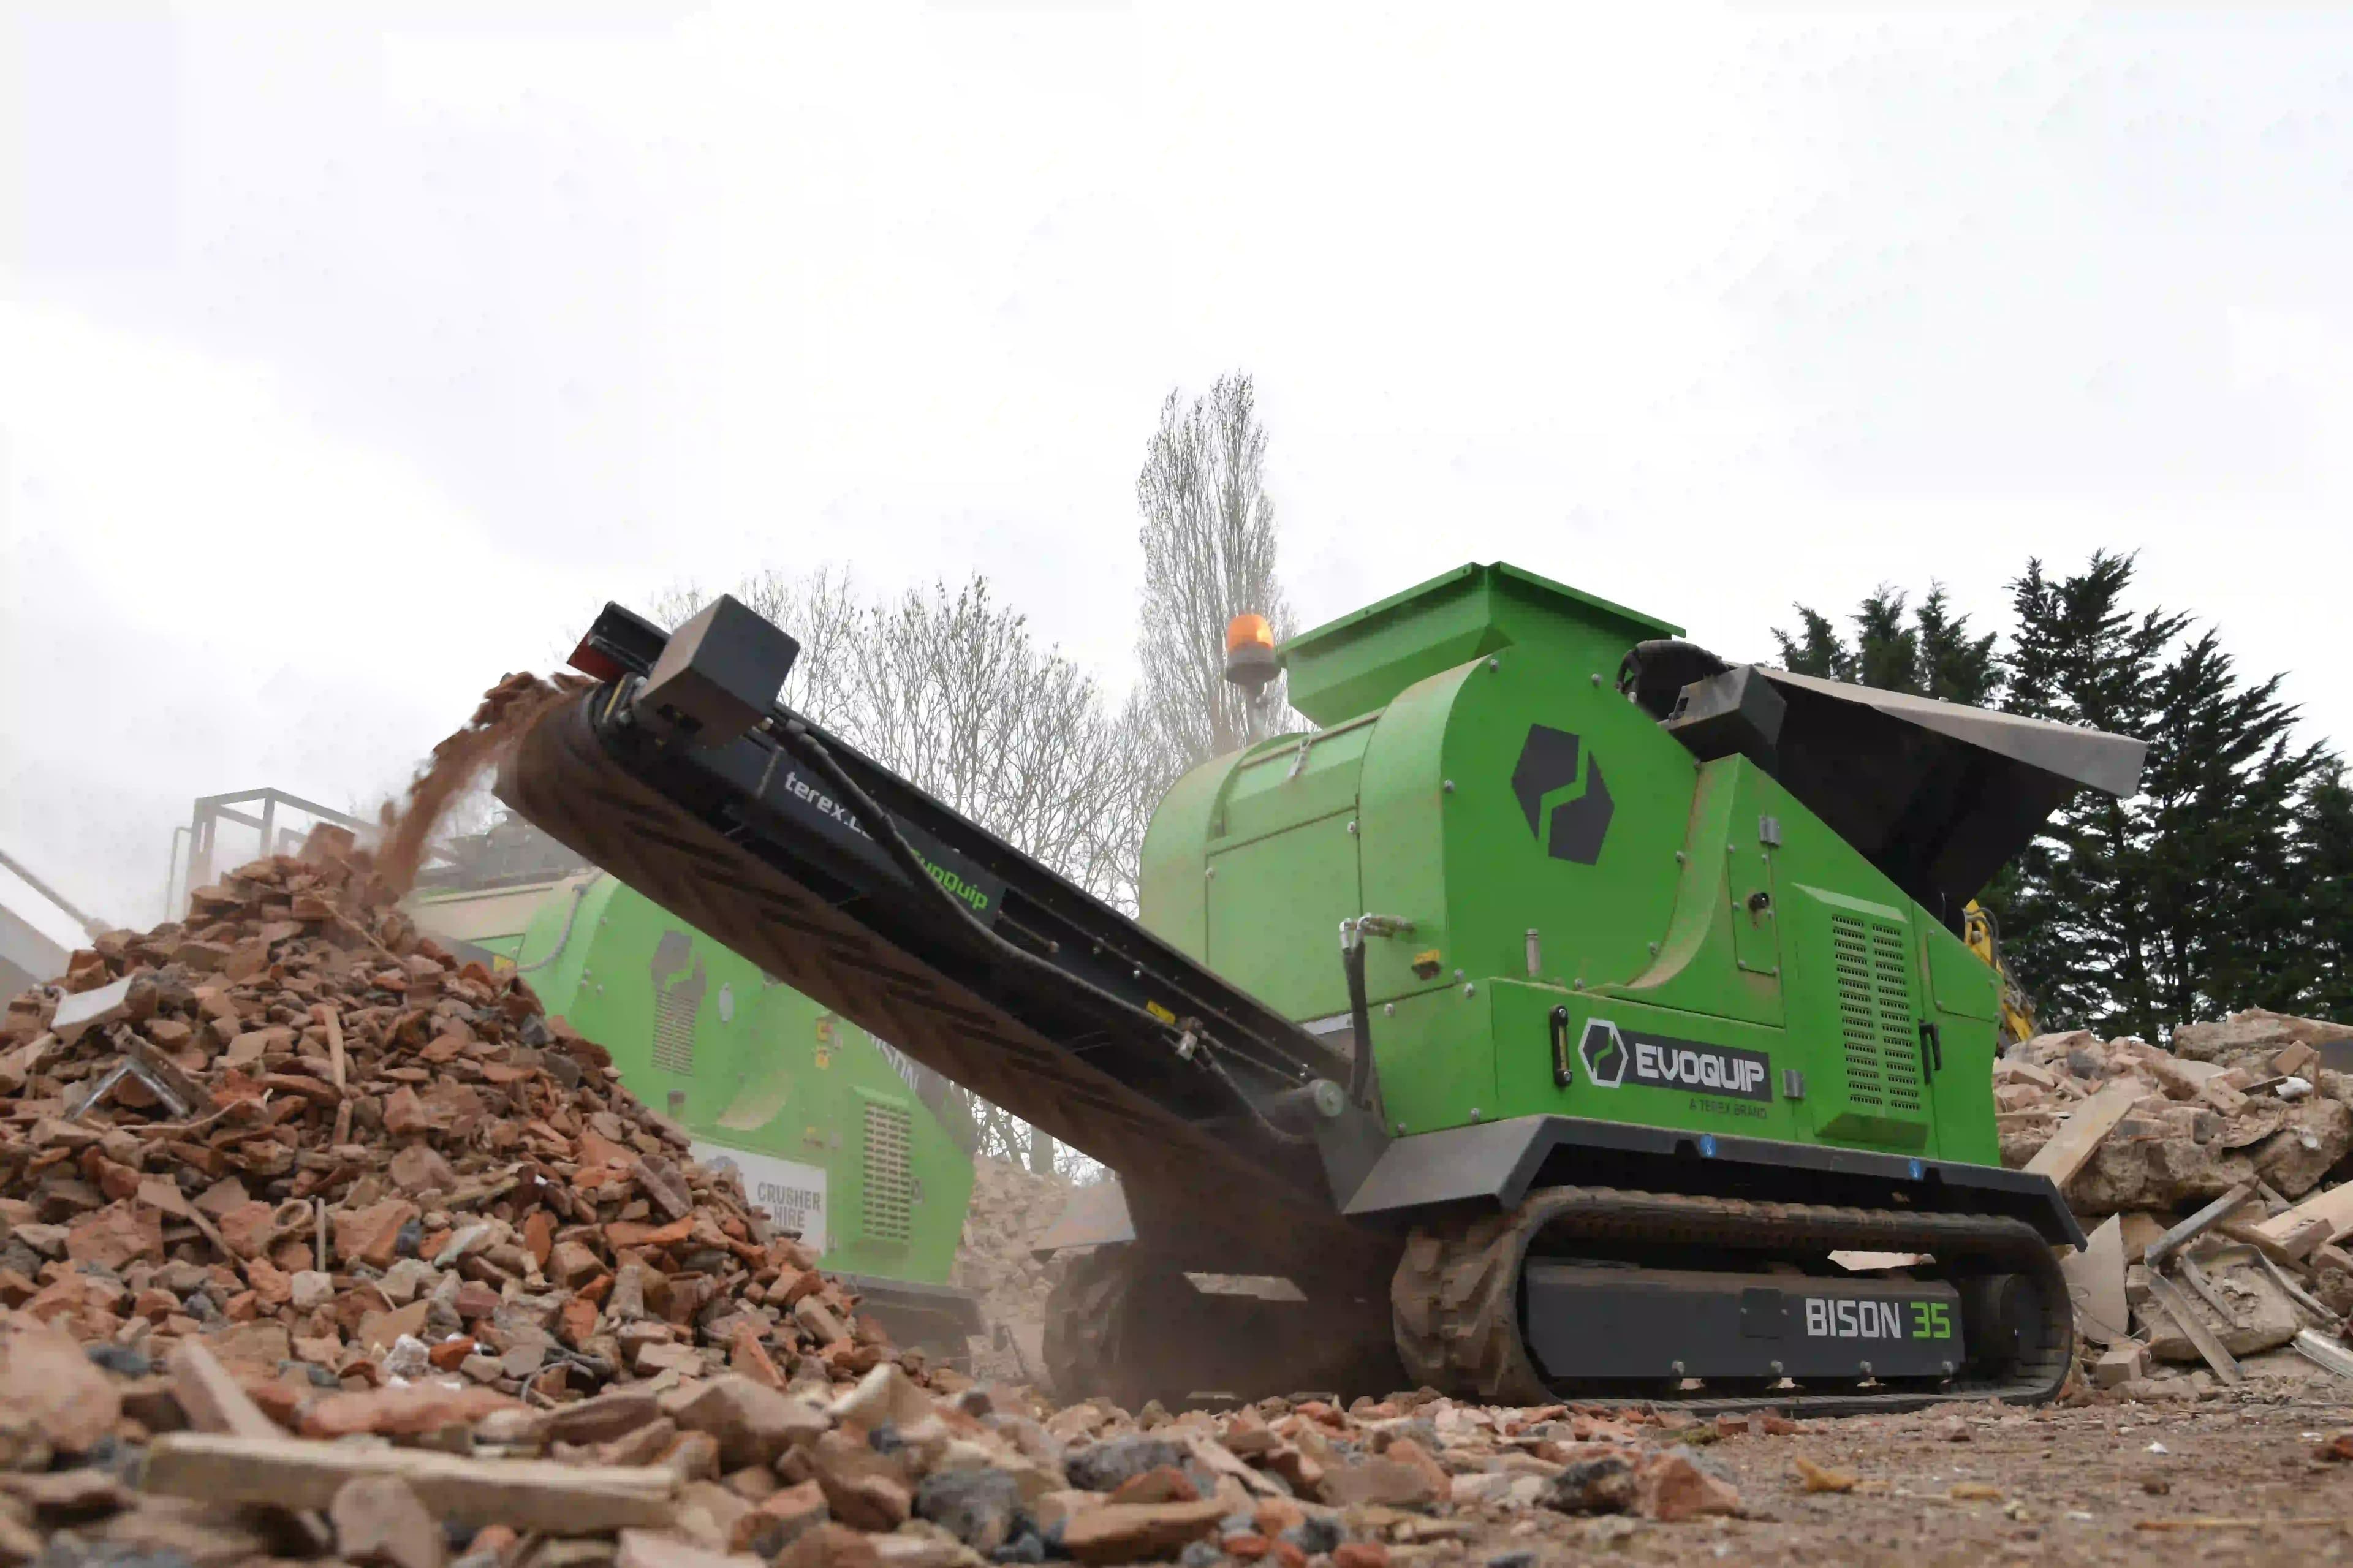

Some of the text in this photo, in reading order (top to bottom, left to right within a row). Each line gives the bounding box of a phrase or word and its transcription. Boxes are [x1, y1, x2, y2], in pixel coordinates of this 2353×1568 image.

[1635, 1043, 1765, 1092] EVOQUIP
[1734, 1103, 1767, 1119] BRAND
[757, 1181, 821, 1212] CRUSHER
[774, 1205, 805, 1229] HIRE
[1805, 1298, 1951, 1338] BISON 35
